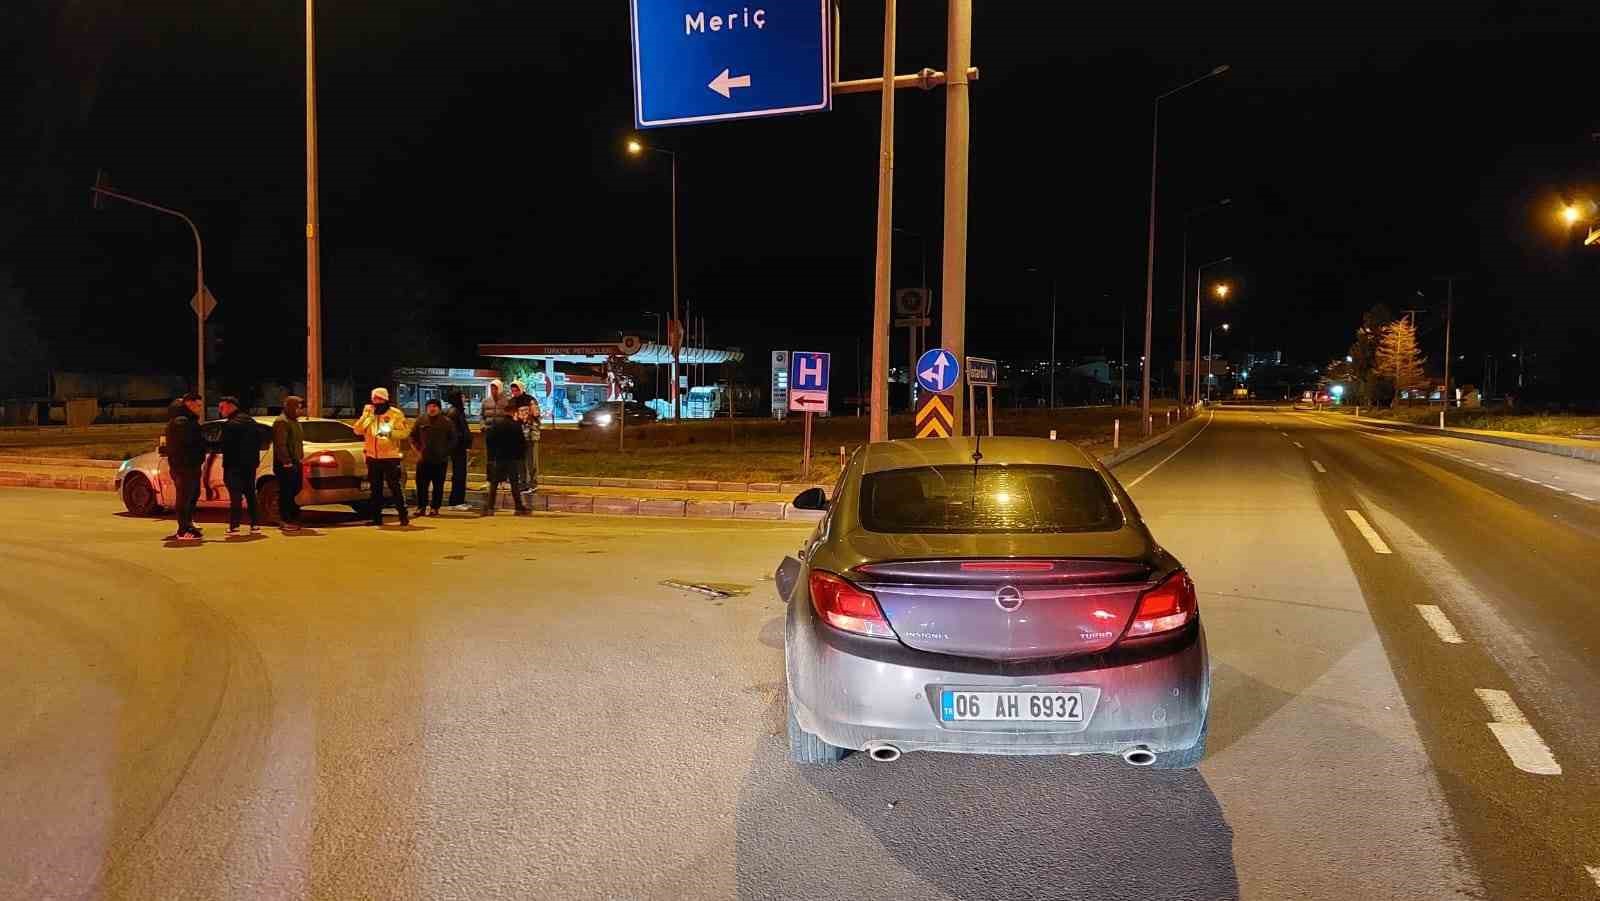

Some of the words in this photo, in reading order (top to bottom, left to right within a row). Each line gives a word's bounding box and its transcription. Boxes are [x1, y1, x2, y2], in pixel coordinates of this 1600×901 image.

[685, 7, 766, 35] Meriç
[800, 357, 822, 386] H
[1079, 631, 1113, 641] TURBO
[956, 694, 980, 717] 06
[995, 694, 1019, 718] AH
[1029, 694, 1079, 718] 6932
